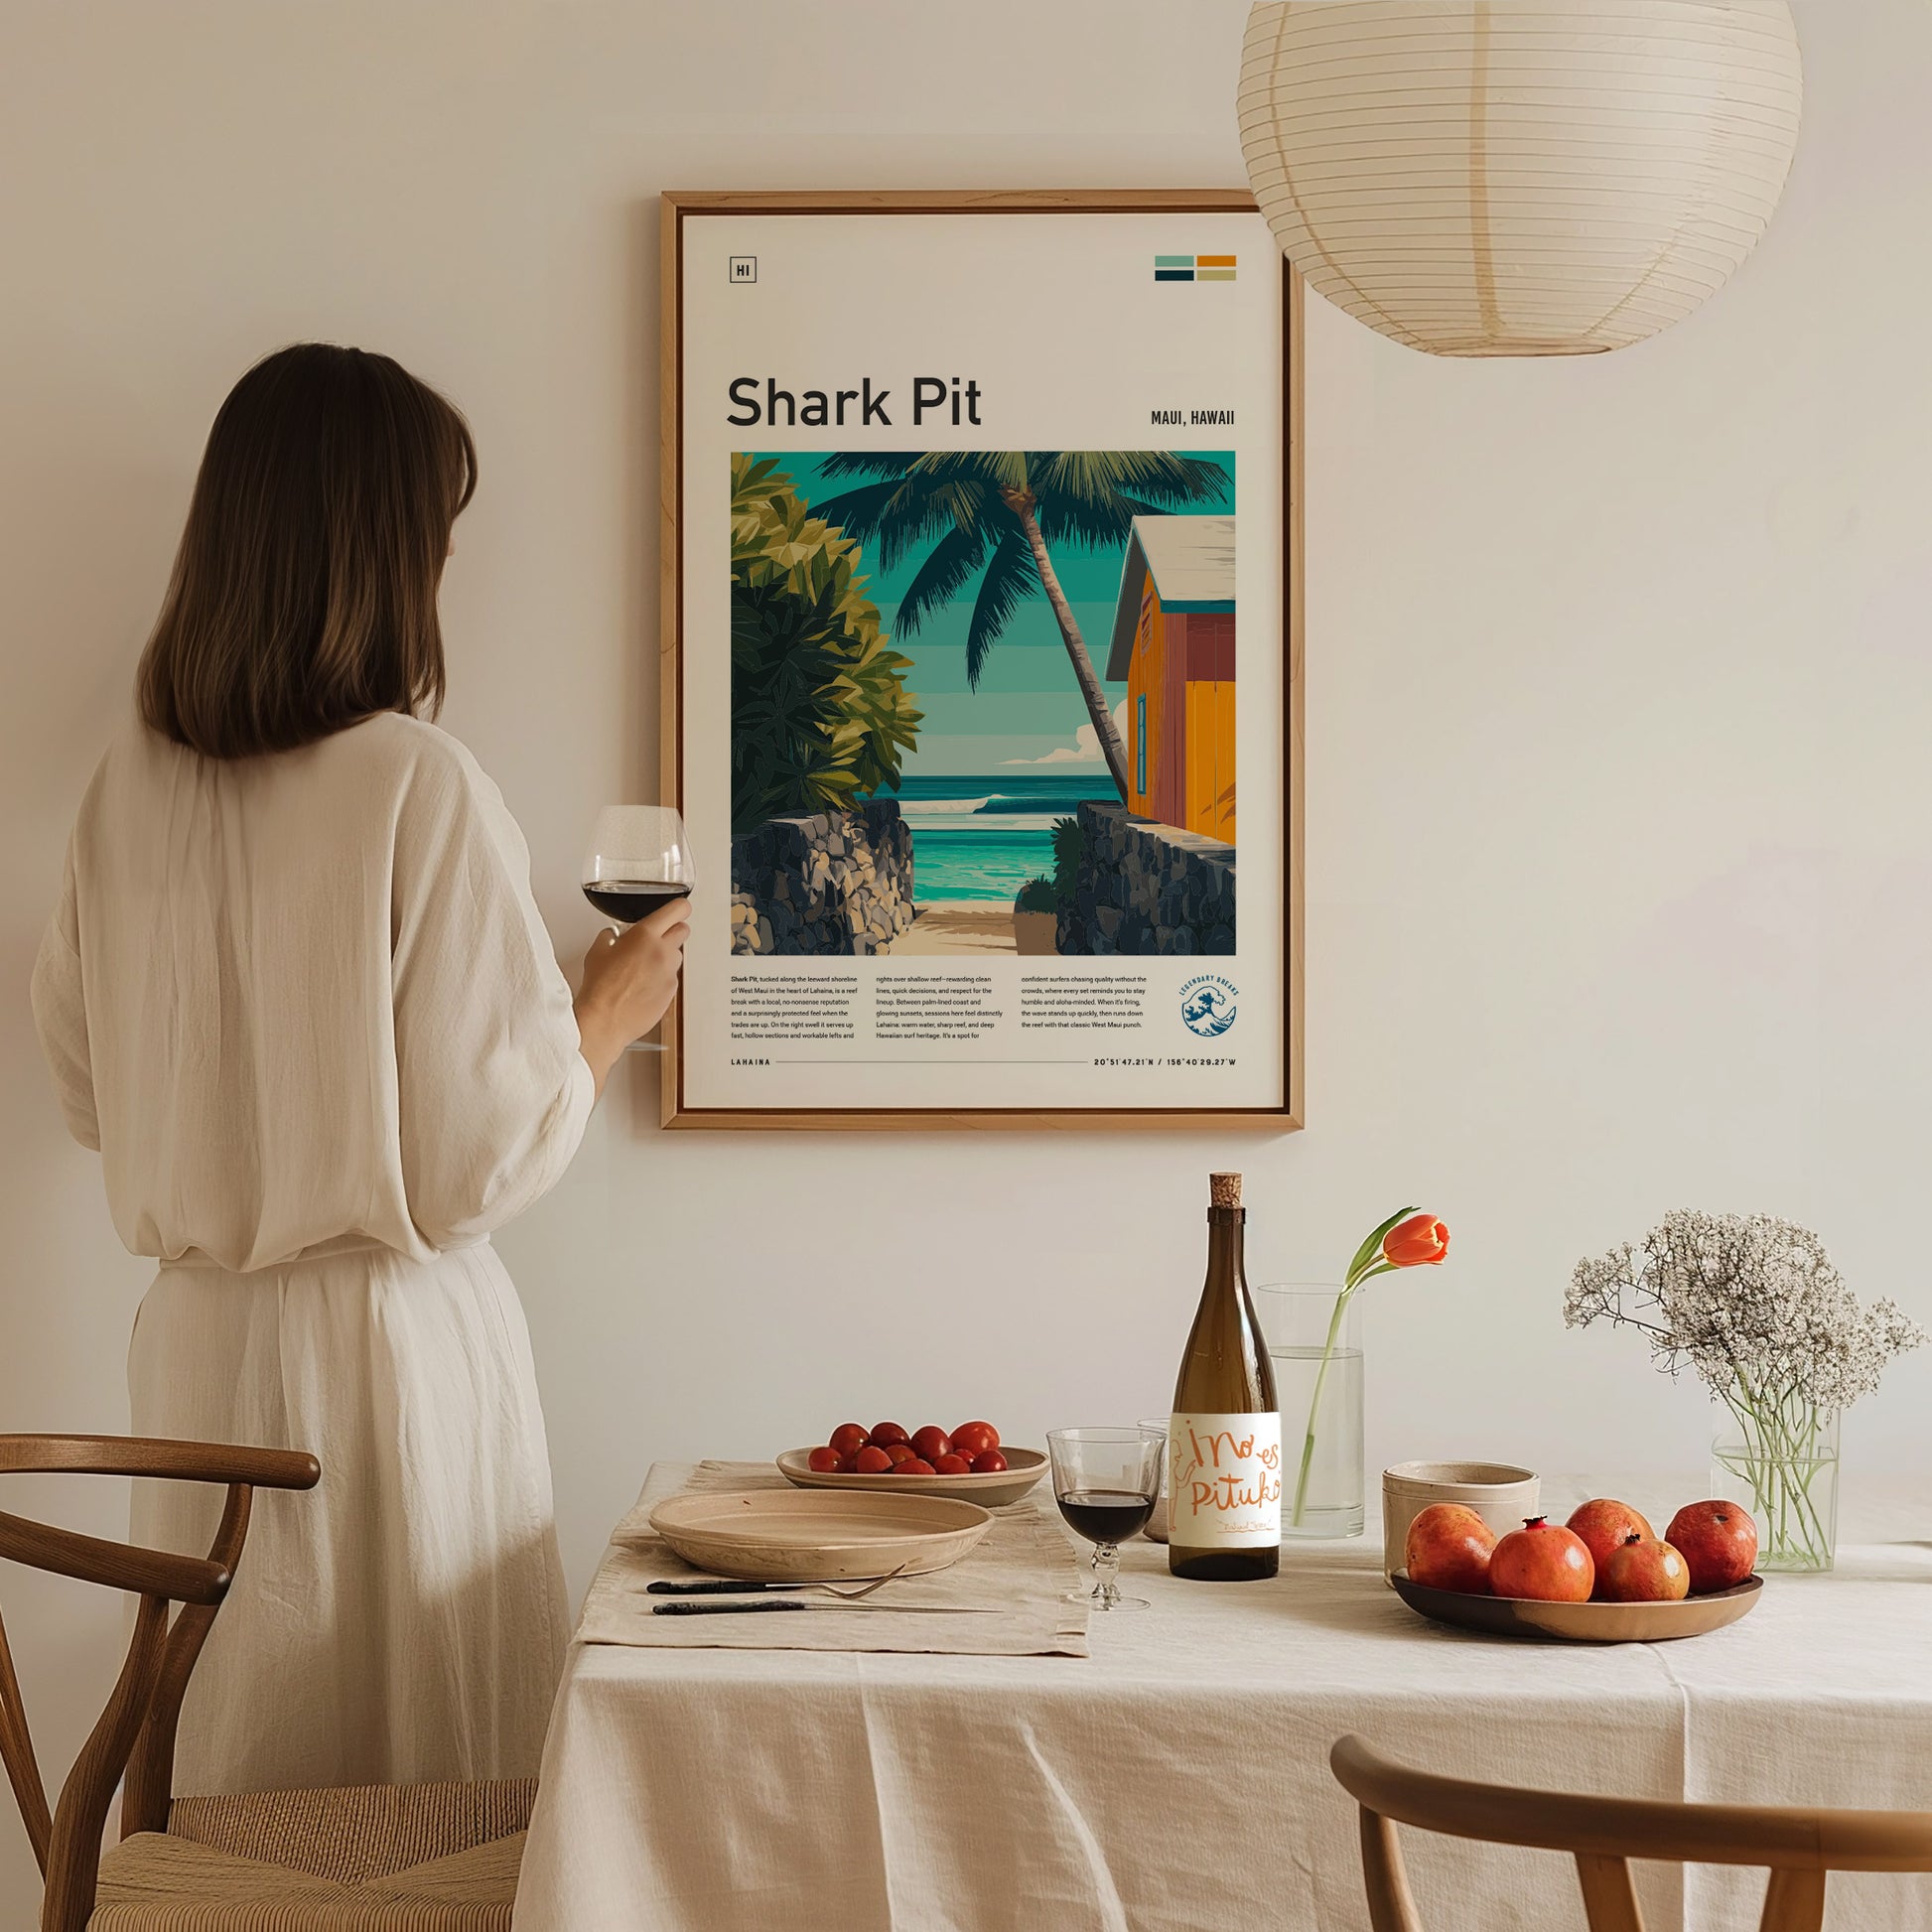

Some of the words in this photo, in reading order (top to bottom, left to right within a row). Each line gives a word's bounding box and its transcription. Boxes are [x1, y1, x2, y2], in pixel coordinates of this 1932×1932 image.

[736, 264, 750, 277] HI
[727, 377, 894, 426] Shark
[912, 377, 982, 426] Pit
[1151, 411, 1186, 427] MAUI,
[1190, 411, 1235, 425] HAWAII
[1178, 974, 1214, 996] LEGENDARY
[1216, 976, 1239, 996] BREAKS
[1256, 1444, 1279, 1469] es
